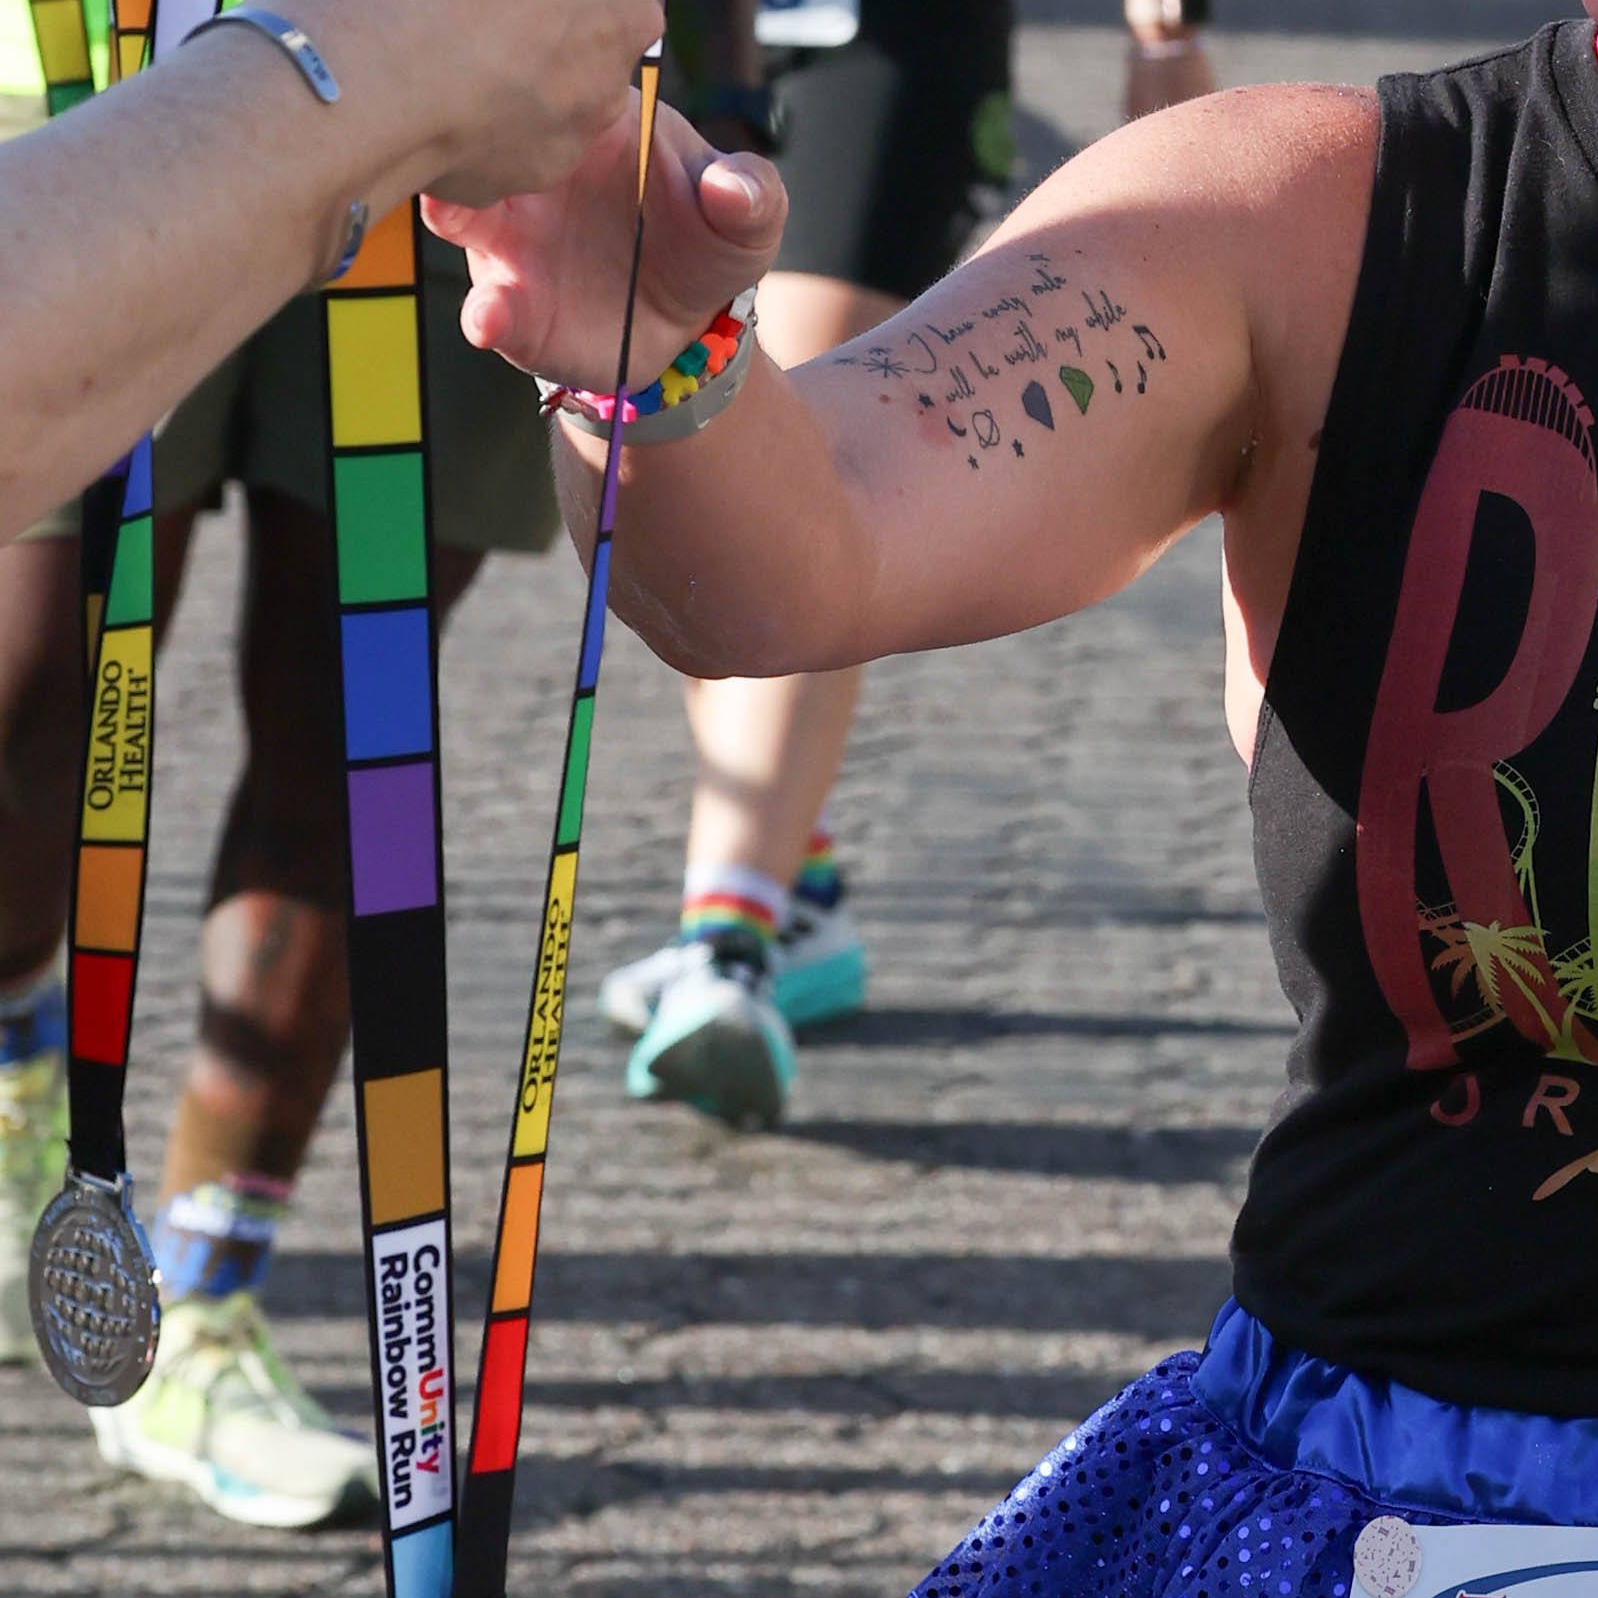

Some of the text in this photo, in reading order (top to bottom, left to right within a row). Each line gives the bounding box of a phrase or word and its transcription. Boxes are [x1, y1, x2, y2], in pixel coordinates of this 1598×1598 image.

[88, 660, 122, 811] ORLANDO
[119, 673, 147, 794] HEALTH
[522, 898, 560, 1114] ORLANDO
[379, 1252, 416, 1509] Rainbow Run
[413, 1244, 445, 1474] CommUnity
